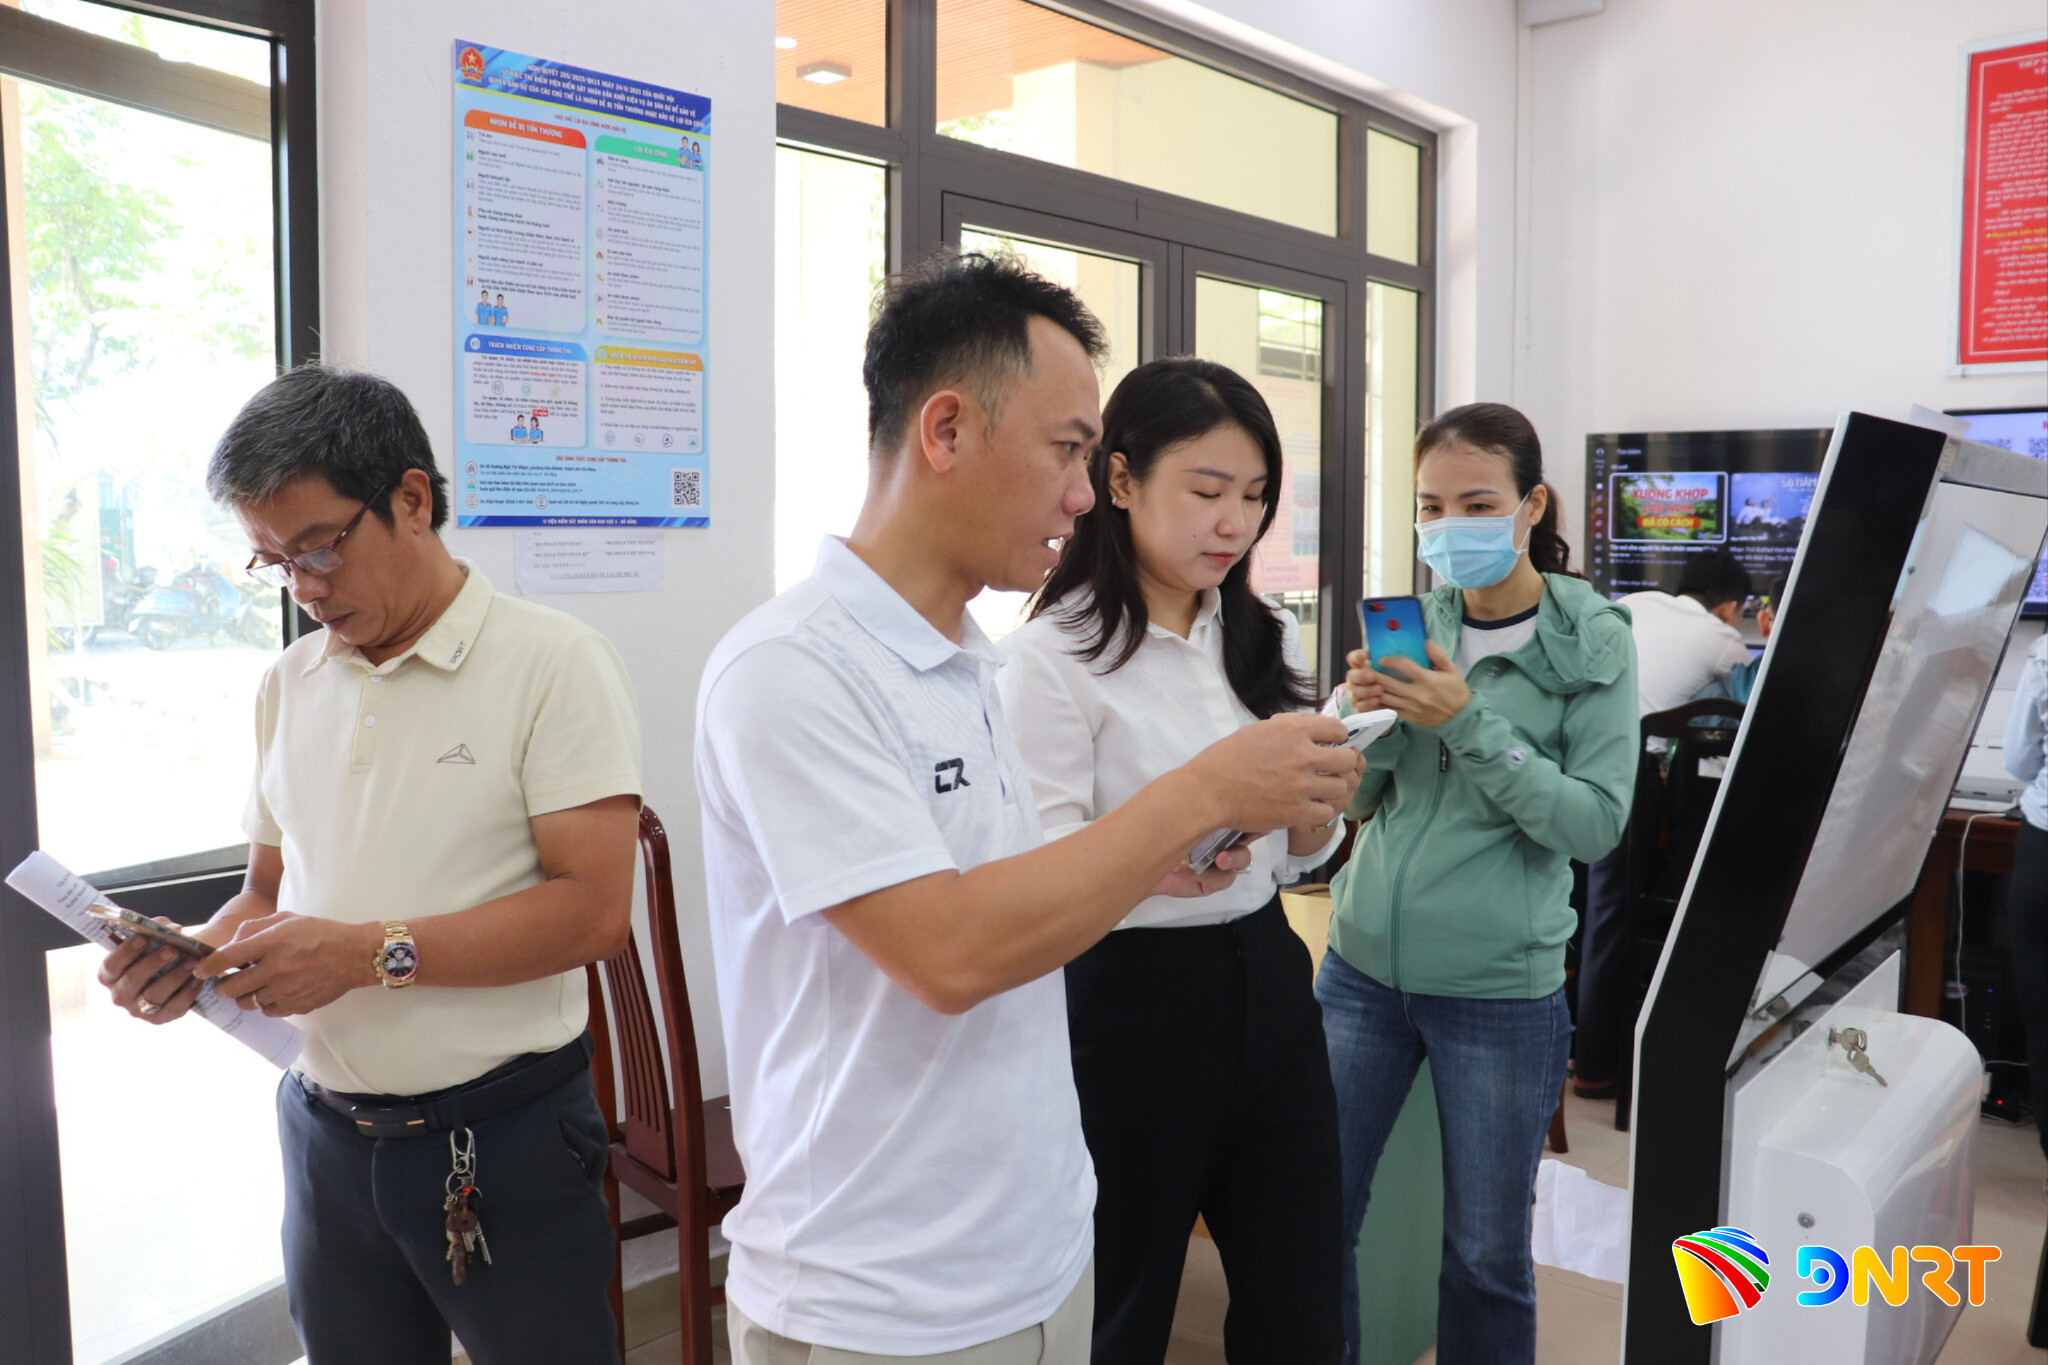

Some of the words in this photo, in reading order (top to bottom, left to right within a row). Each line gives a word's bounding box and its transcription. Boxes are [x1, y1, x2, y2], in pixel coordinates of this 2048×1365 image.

[490, 117, 507, 127] NHÓM
[509, 120, 517, 129] DỄ
[518, 124, 525, 132] BỊ
[526, 123, 538, 133] TỔN
[540, 128, 563, 138] THƯƠNG
[1632, 488, 1673, 500] XƯƠNG
[1675, 487, 1709, 499] KHỚP
[1657, 518, 1669, 527] CÓ
[1670, 517, 1694, 527] CÁCH
[449, 640, 466, 664] SPORT
